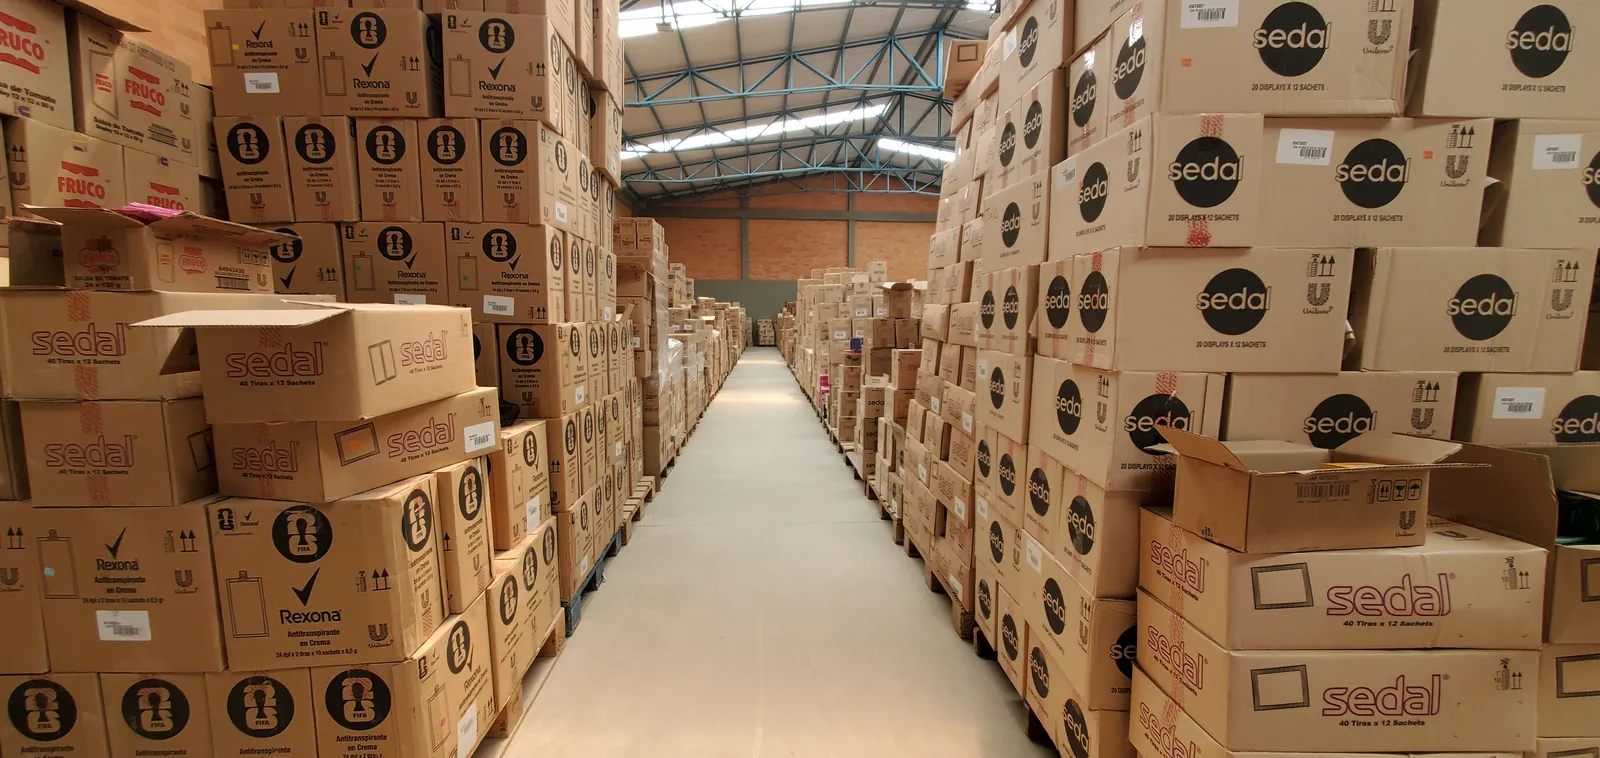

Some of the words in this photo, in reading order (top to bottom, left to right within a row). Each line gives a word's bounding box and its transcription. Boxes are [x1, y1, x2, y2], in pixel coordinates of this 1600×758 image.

[0, 28, 44, 61] RUCO
[246, 40, 273, 48] Rexona
[1253, 22, 1332, 49] sedal
[1505, 25, 1576, 52] sedal
[1363, 46, 1392, 54] Unilever
[24, 88, 56, 104] Tomate
[125, 78, 165, 106] FRUCO
[353, 78, 390, 89] Rexona
[479, 81, 516, 92] Rexona
[1168, 155, 1245, 182] sedal
[1335, 157, 1411, 183] sedal
[58, 177, 105, 200] FRUCO
[182, 257, 205, 268] FRUCO
[1077, 286, 1110, 311] sedal
[1196, 285, 1272, 312] sedal
[1446, 292, 1519, 317] sedal
[32, 323, 126, 356] sedal
[401, 330, 448, 366] sedal
[226, 342, 324, 378] sedal
[1124, 410, 1195, 433] sedal
[1303, 410, 1378, 435] sedal
[1551, 412, 1600, 435] sed
[387, 412, 455, 458] sedal
[45, 435, 135, 468] sedal
[232, 440, 298, 473] sedal
[431, 446, 449, 455] Sachets
[96, 559, 139, 571] Rexona
[1150, 540, 1205, 594] sedal
[1326, 573, 1452, 617] sedal
[280, 609, 341, 624] Rexona
[288, 629, 340, 638] Antitranspirante
[1148, 625, 1203, 690] sedal
[1322, 674, 1441, 716] sedal
[336, 734, 387, 742] Antitranspirante
[1139, 702, 1196, 758] sedal
